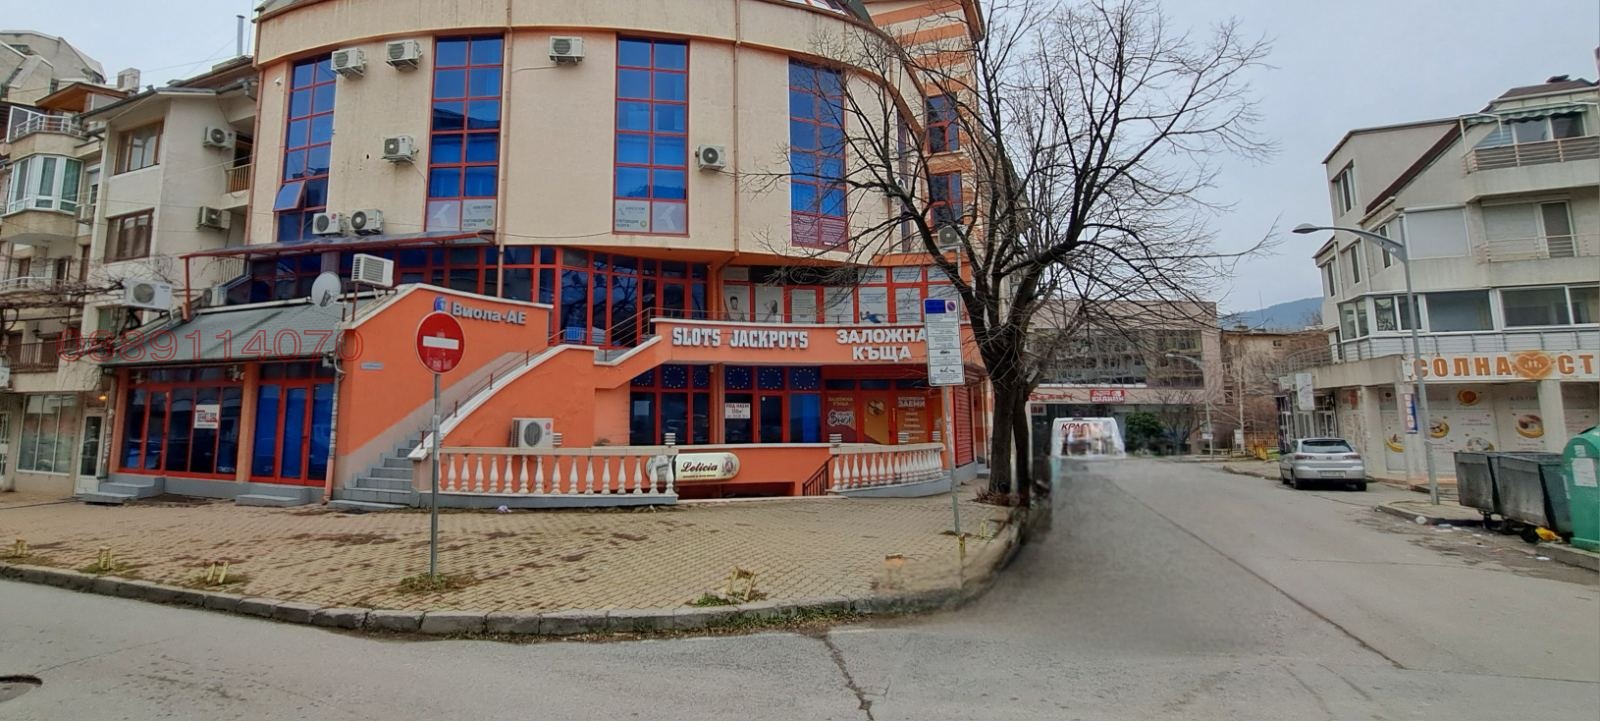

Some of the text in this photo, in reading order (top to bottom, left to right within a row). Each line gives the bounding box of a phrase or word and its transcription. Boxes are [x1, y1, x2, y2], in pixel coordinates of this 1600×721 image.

[672, 327, 809, 348] SLOTS JACKPOTS
[836, 327, 928, 344] ЗАЛОЖНА
[852, 345, 912, 362] КЪЩА
